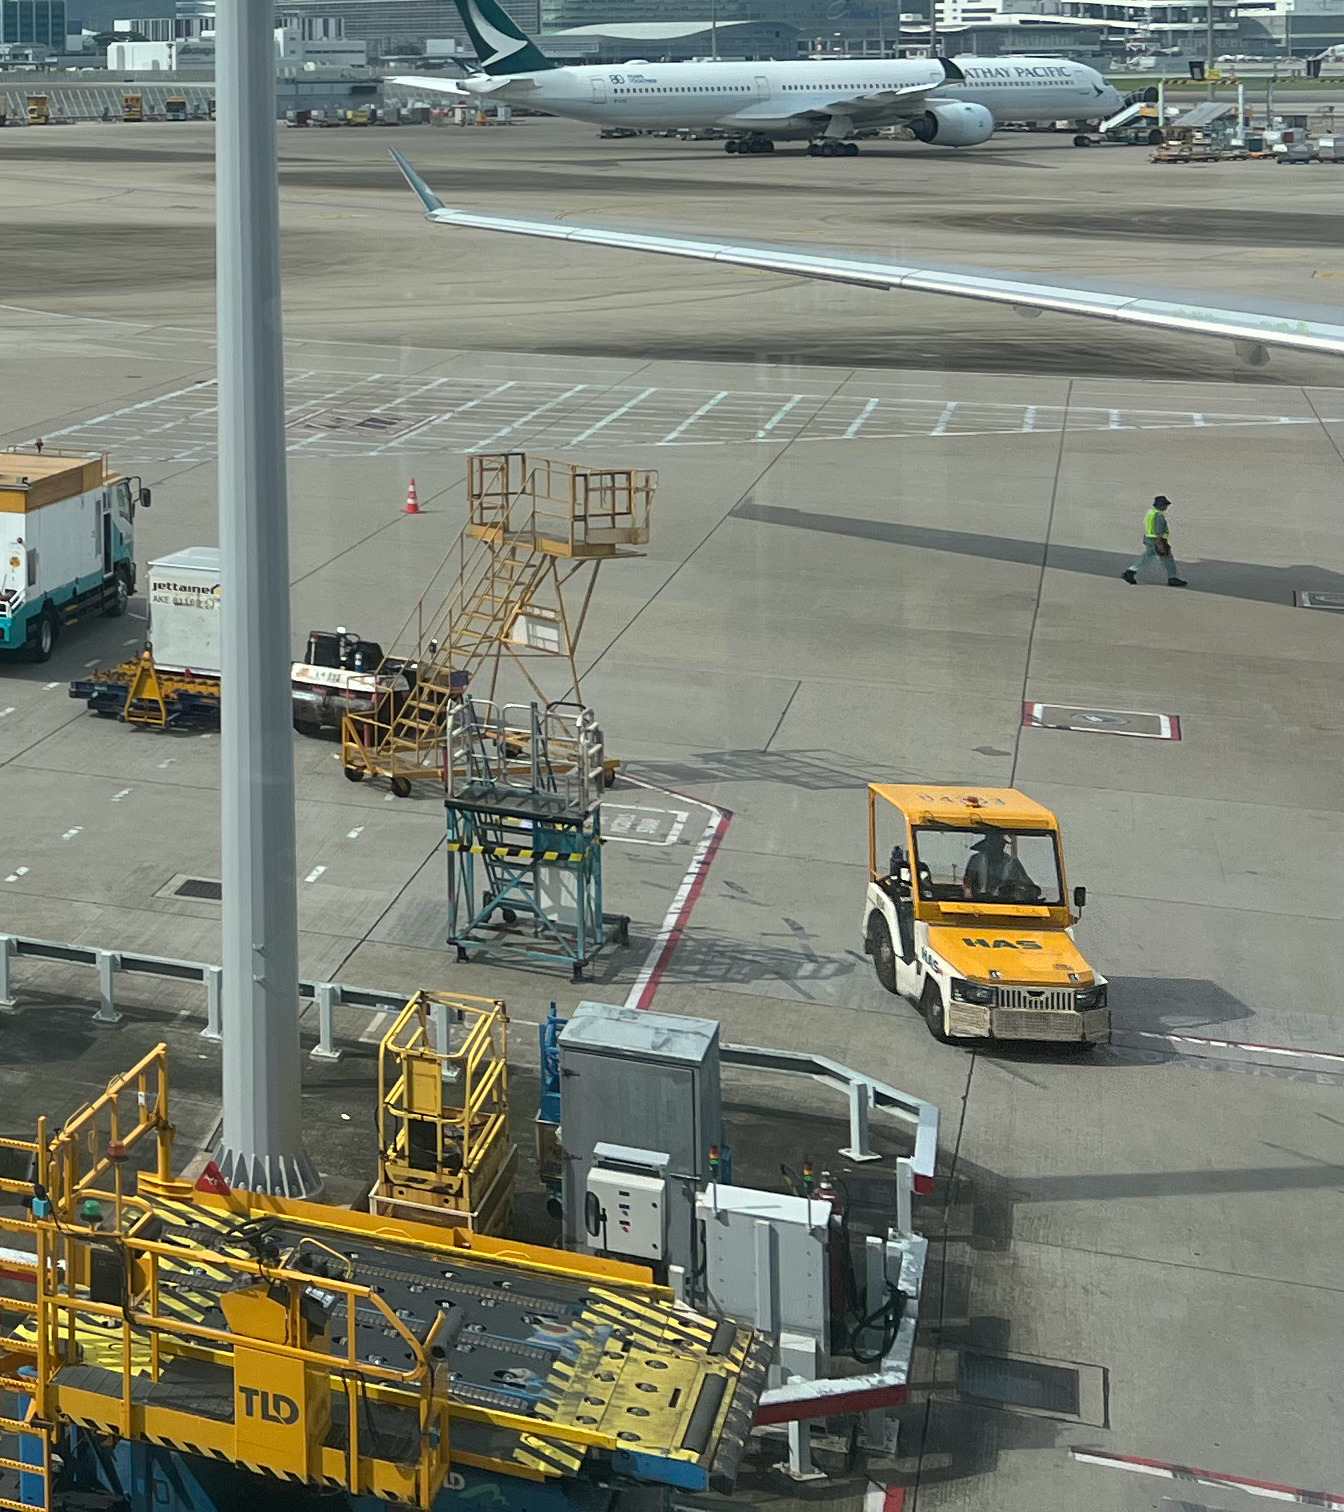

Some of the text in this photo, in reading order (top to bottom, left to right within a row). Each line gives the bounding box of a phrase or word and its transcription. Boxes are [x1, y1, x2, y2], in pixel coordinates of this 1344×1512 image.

[964, 66, 1072, 79] ATHAY PACIFIC
[962, 938, 1044, 951] HAS
[238, 1386, 300, 1426] TLD
